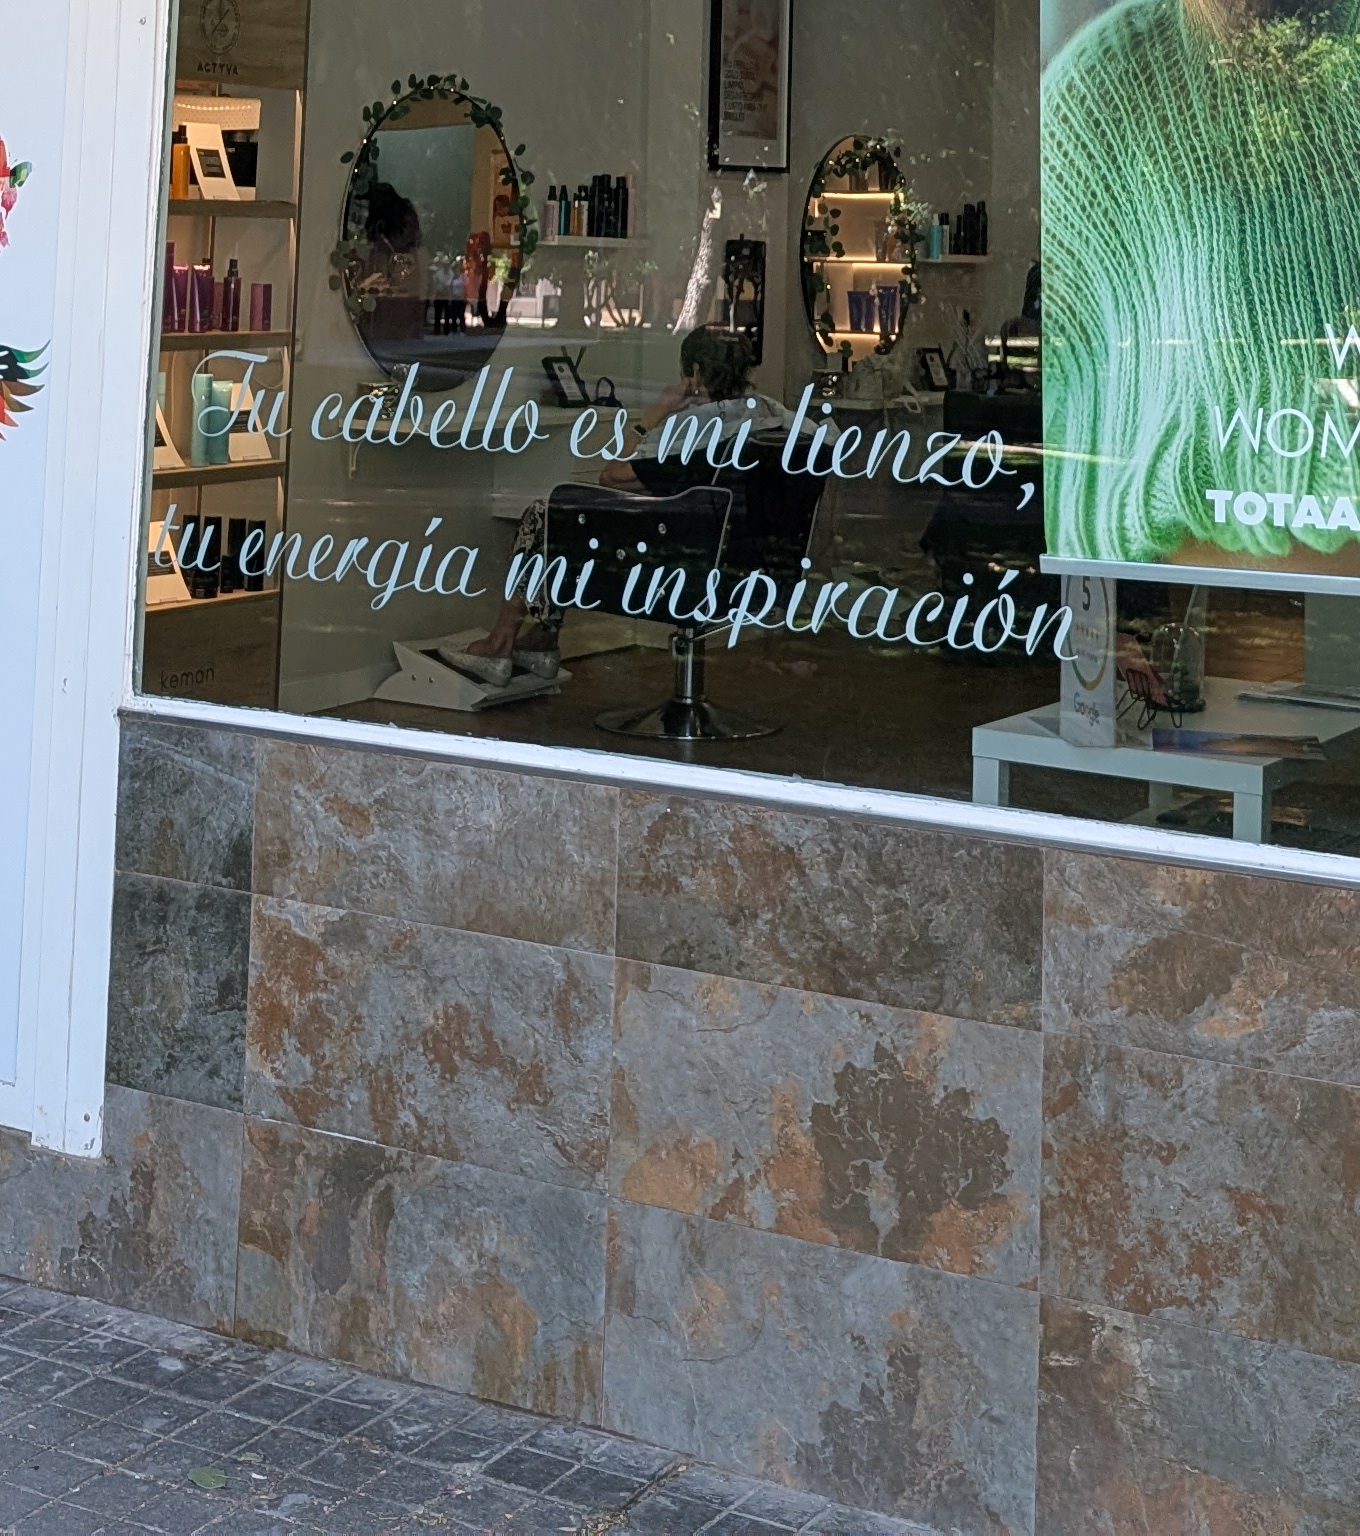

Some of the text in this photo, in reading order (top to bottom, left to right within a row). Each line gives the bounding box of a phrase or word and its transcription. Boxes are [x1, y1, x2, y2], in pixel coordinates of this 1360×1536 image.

[192, 350, 1036, 511] Tu cabello es mi lienzo,
[154, 503, 1079, 661] tu energía mi inspiración
[160, 667, 215, 691] kemon
